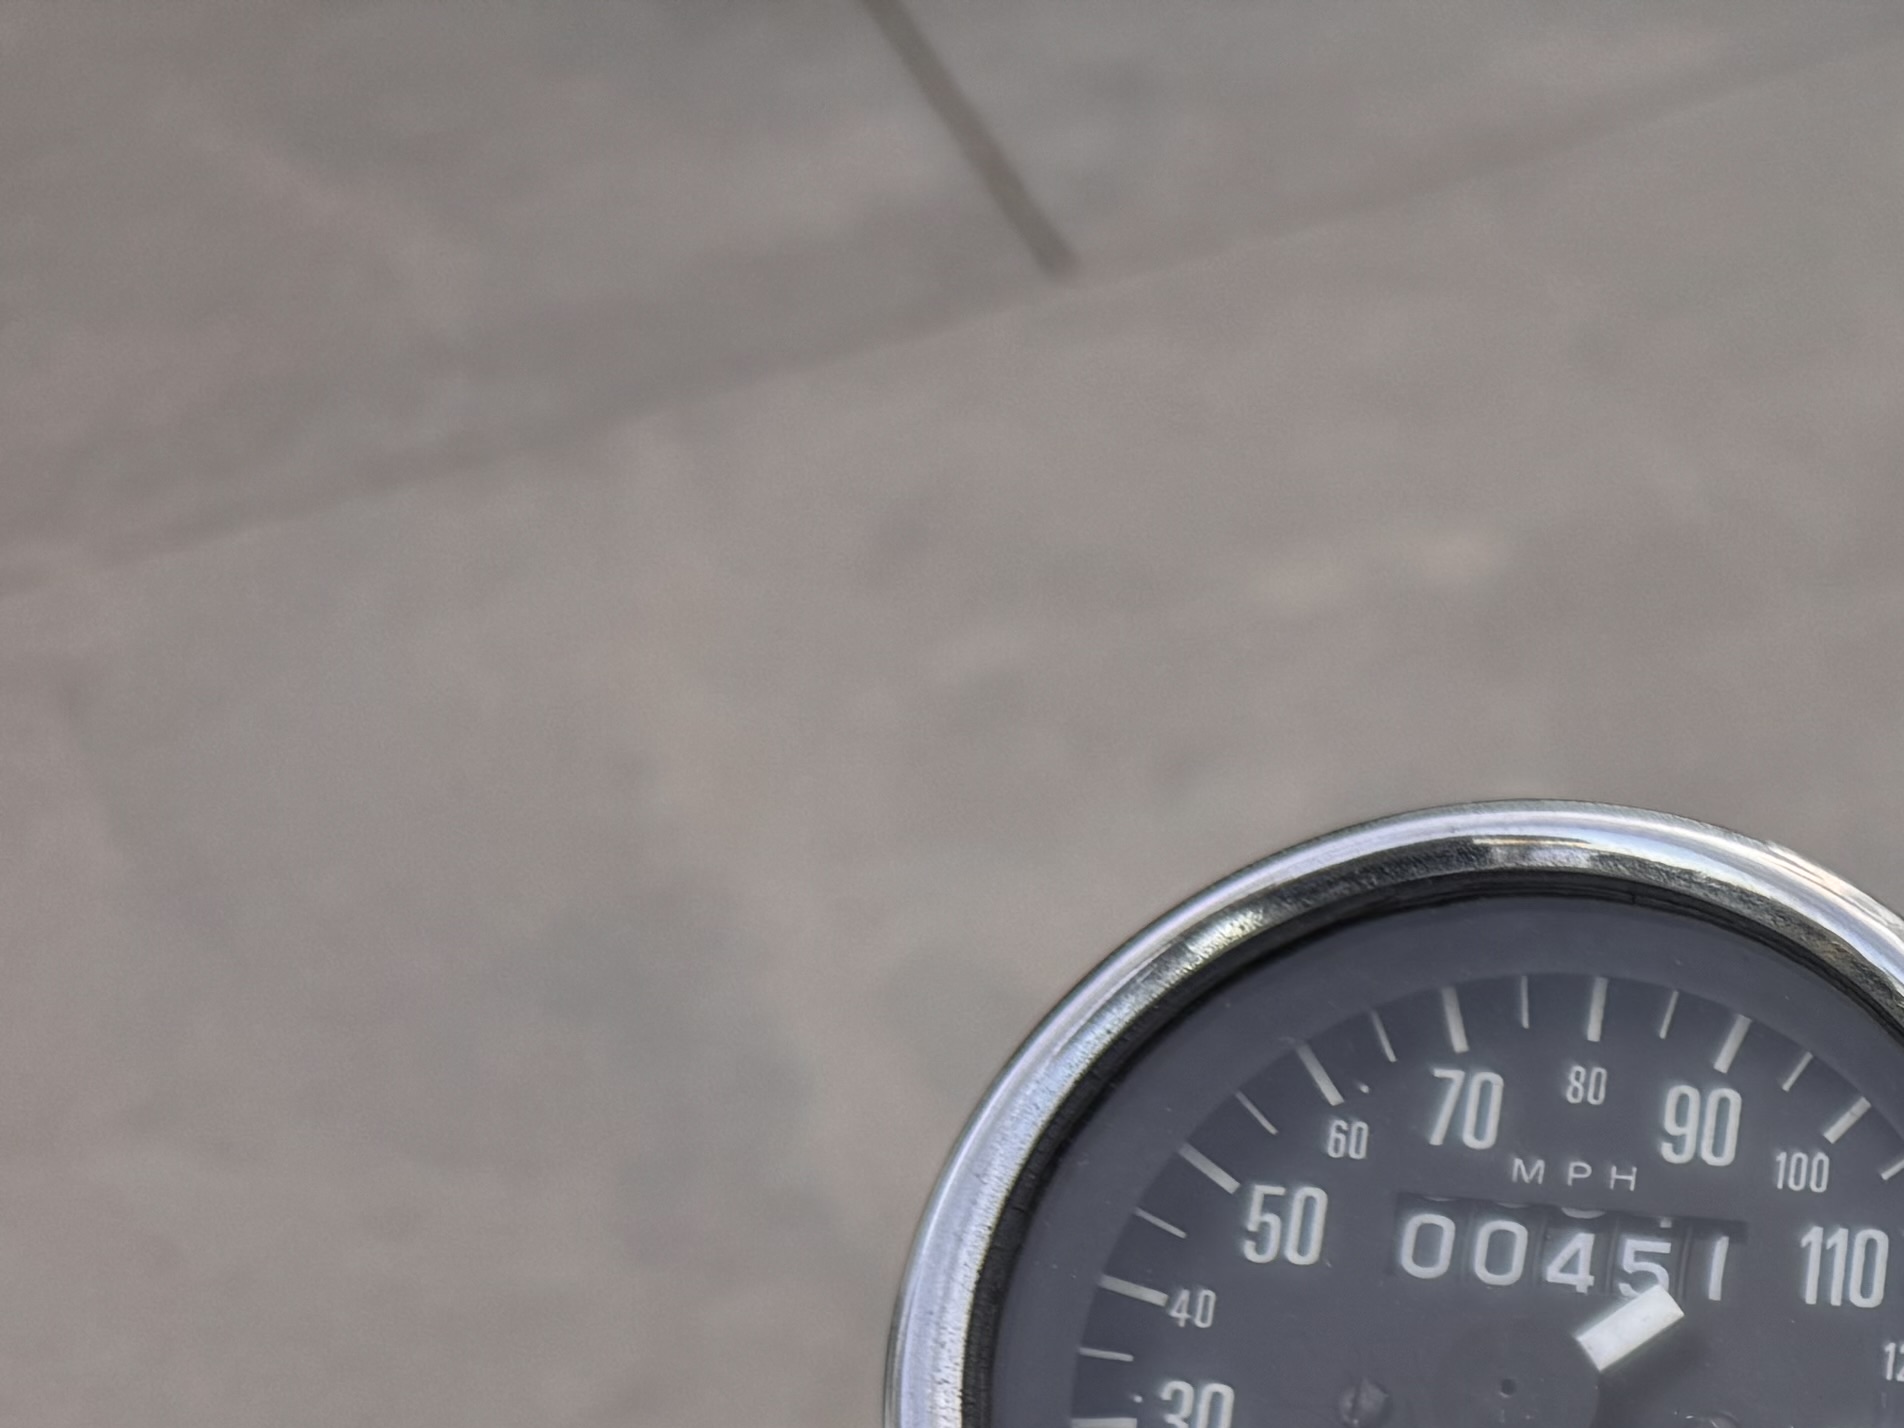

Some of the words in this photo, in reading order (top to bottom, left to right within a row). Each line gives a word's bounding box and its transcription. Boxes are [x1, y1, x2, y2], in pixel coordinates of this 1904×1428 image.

[1566, 1066, 1607, 1105] 80
[1430, 1069, 1504, 1149] 70
[1661, 1085, 1742, 1166] 90
[1327, 1121, 1369, 1159] 60
[1512, 1158, 1638, 1191] MPH
[1776, 1152, 1829, 1193] 100
[1243, 1185, 1328, 1266] 50
[1801, 1226, 1889, 1308] 110
[1169, 1289, 1217, 1328] 40
